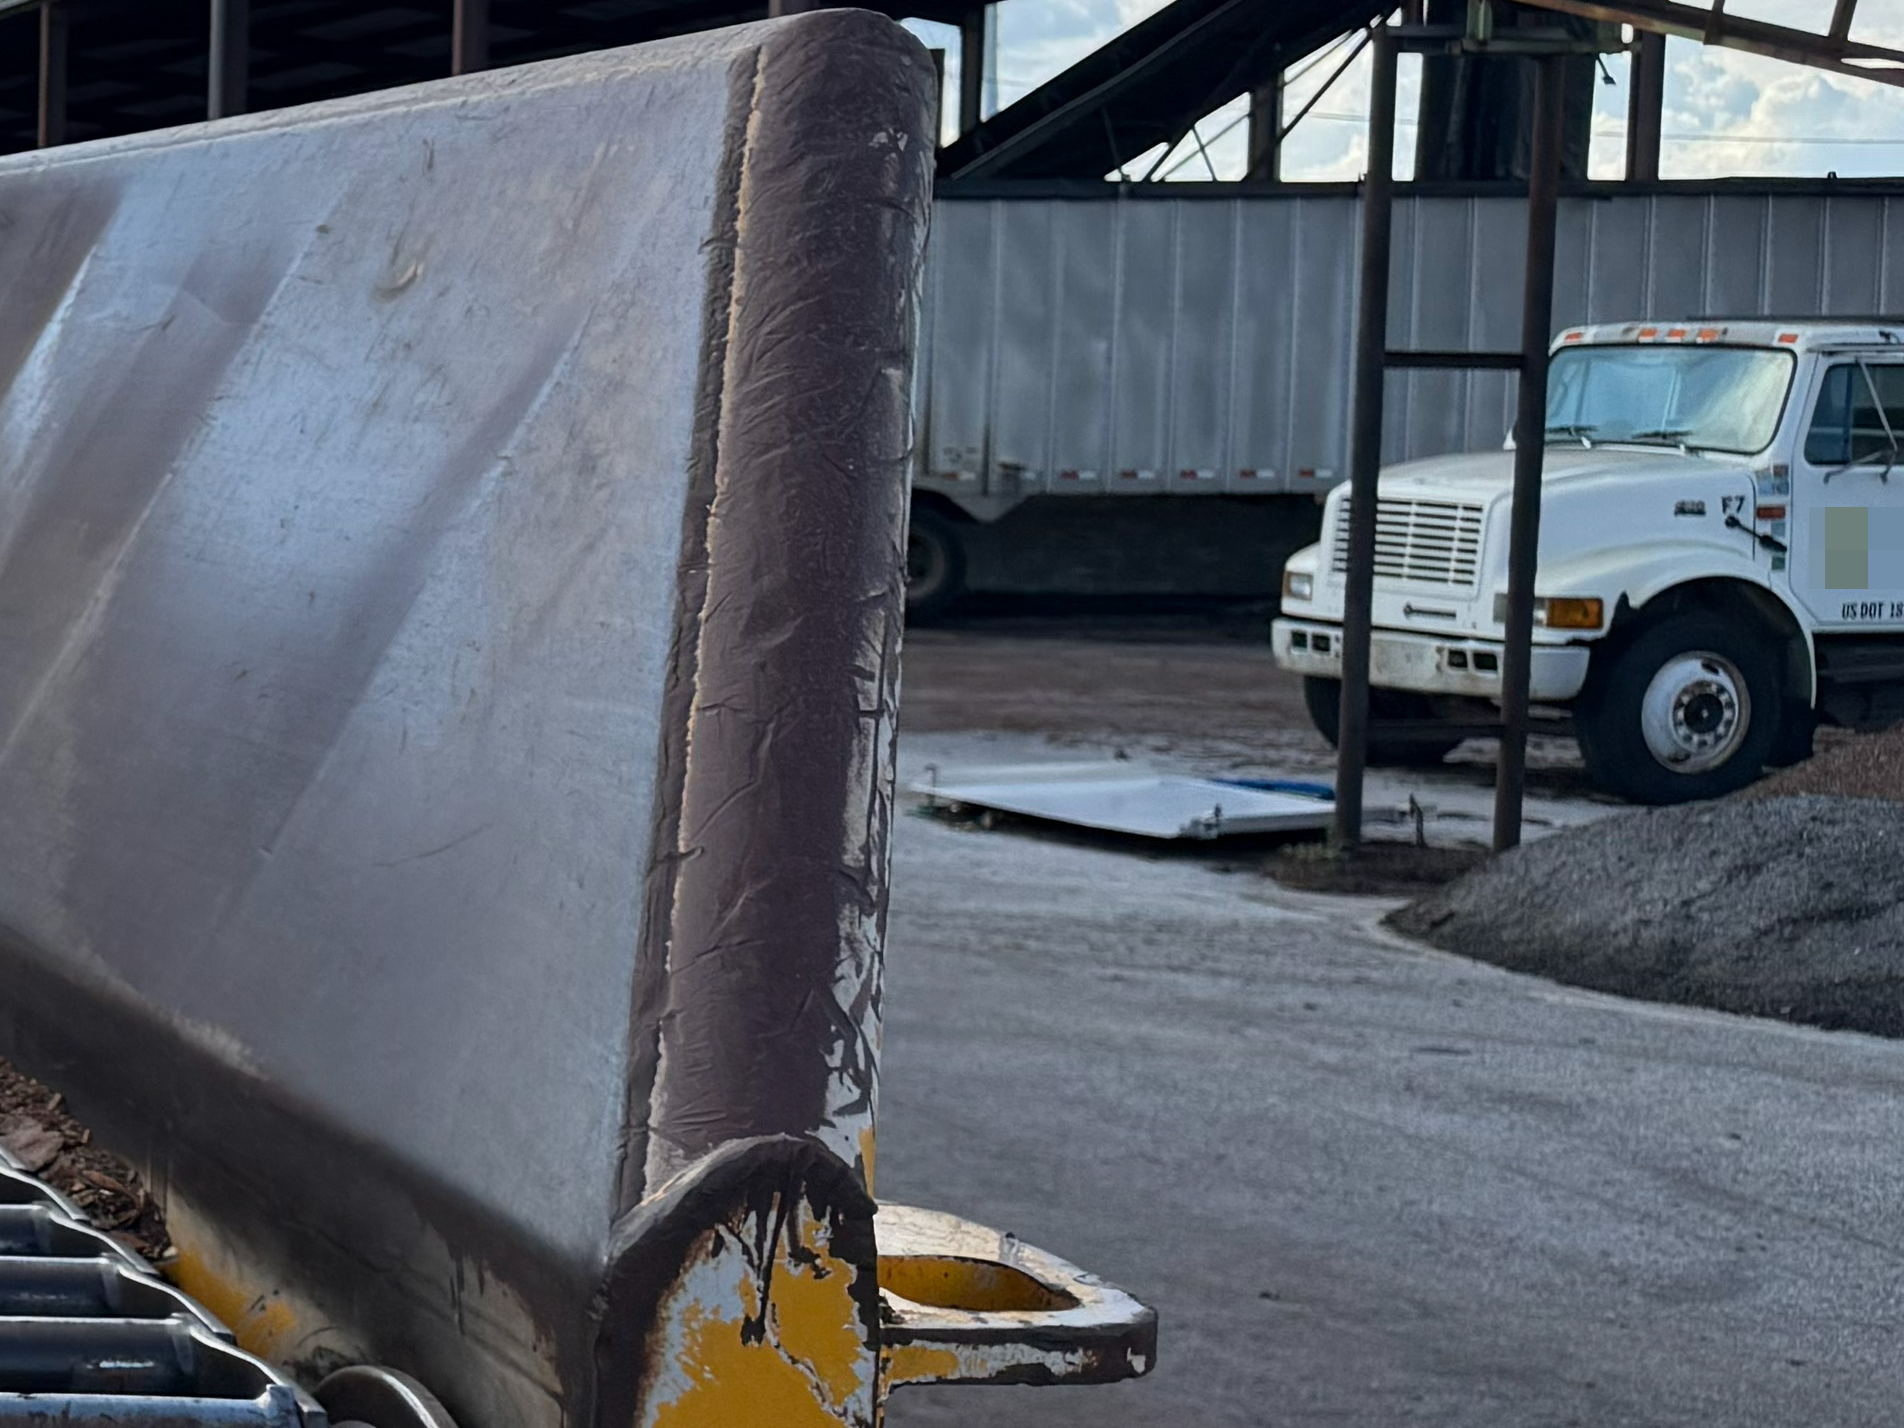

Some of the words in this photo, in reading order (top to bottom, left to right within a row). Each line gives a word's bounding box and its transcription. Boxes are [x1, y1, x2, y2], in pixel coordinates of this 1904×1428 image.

[1721, 495, 1745, 514] F7
[1842, 603, 1858, 620] US
[1860, 601, 1884, 619] DOT
